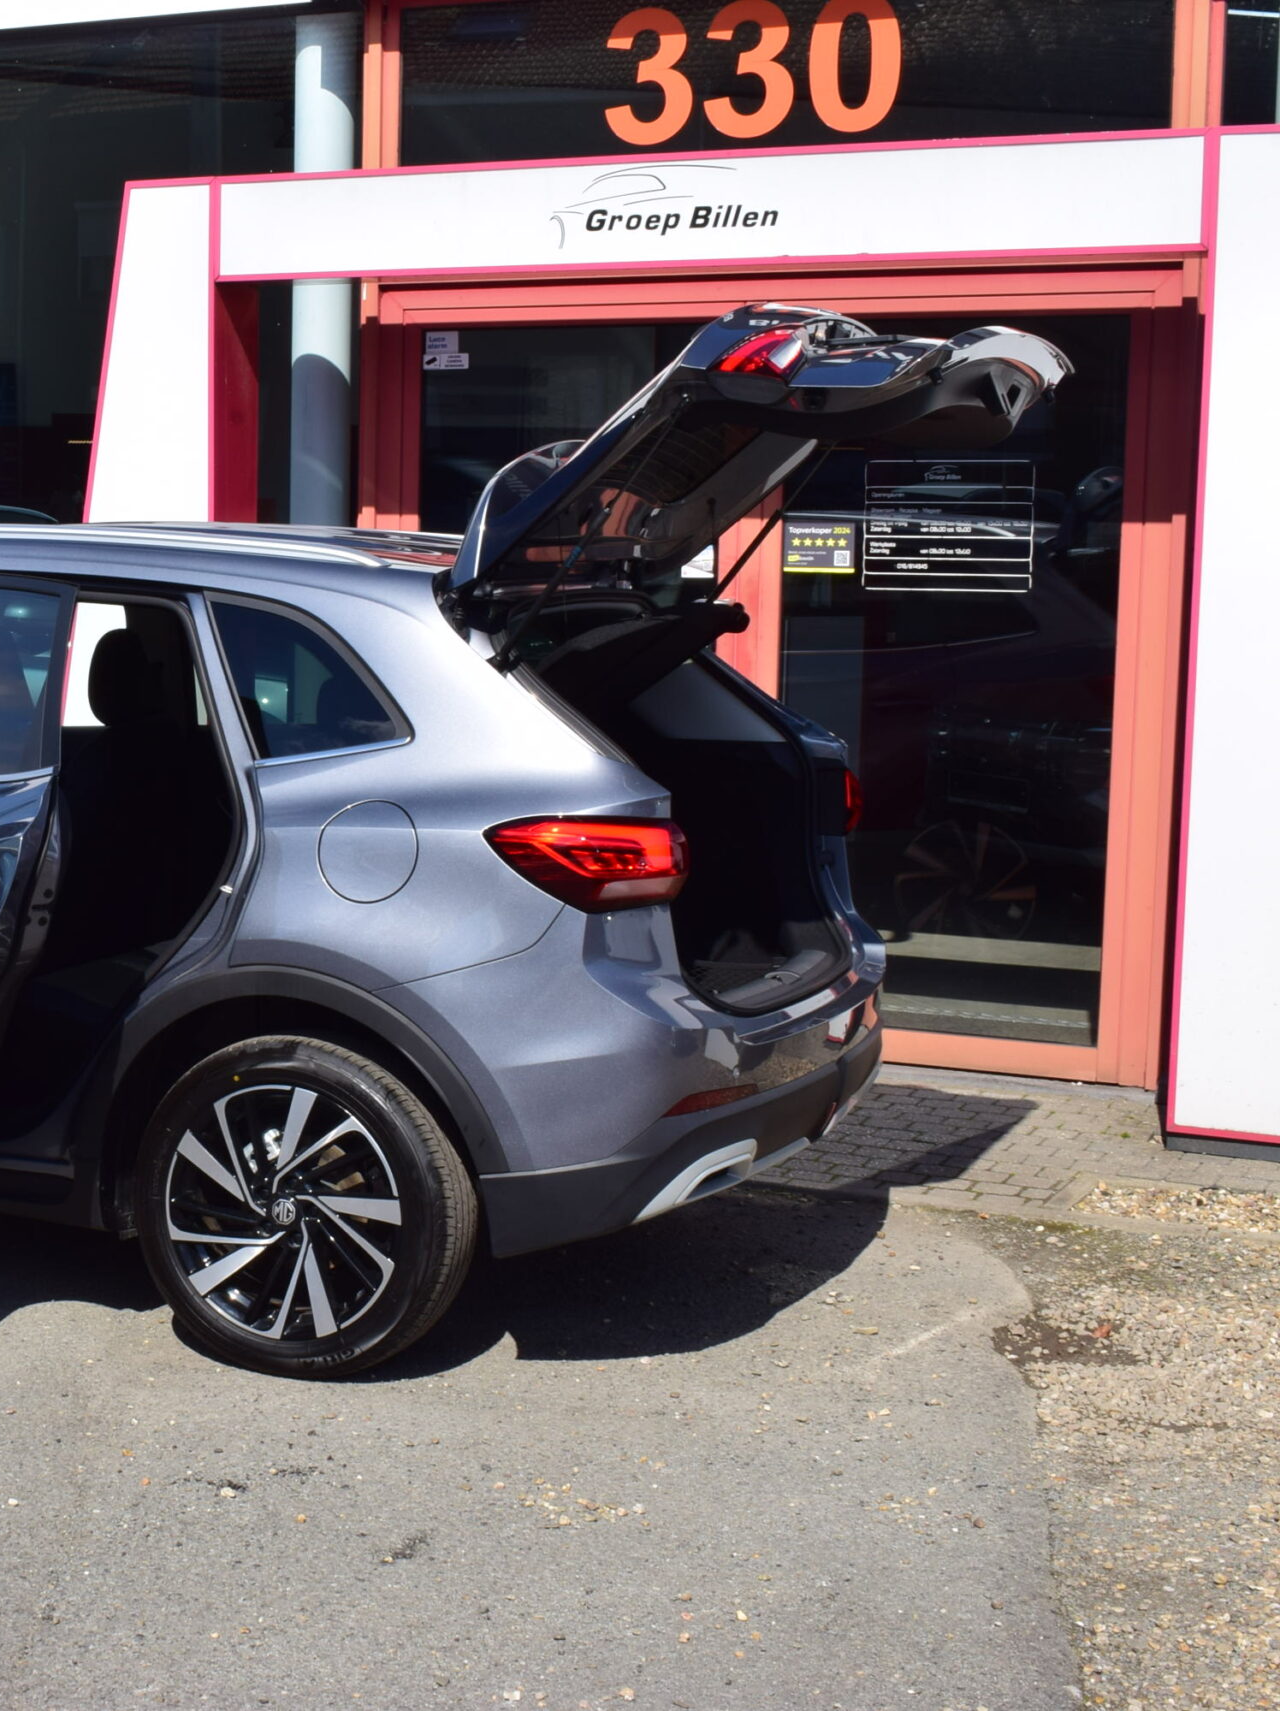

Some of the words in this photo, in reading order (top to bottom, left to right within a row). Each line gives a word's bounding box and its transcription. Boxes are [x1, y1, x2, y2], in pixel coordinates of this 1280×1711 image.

[604, 0, 902, 146] 330
[585, 208, 681, 236] Groep
[689, 204, 779, 230] Billen
[788, 526, 832, 535] Topverkoper
[832, 526, 851, 535] 2024
[273, 1200, 294, 1223] MG
